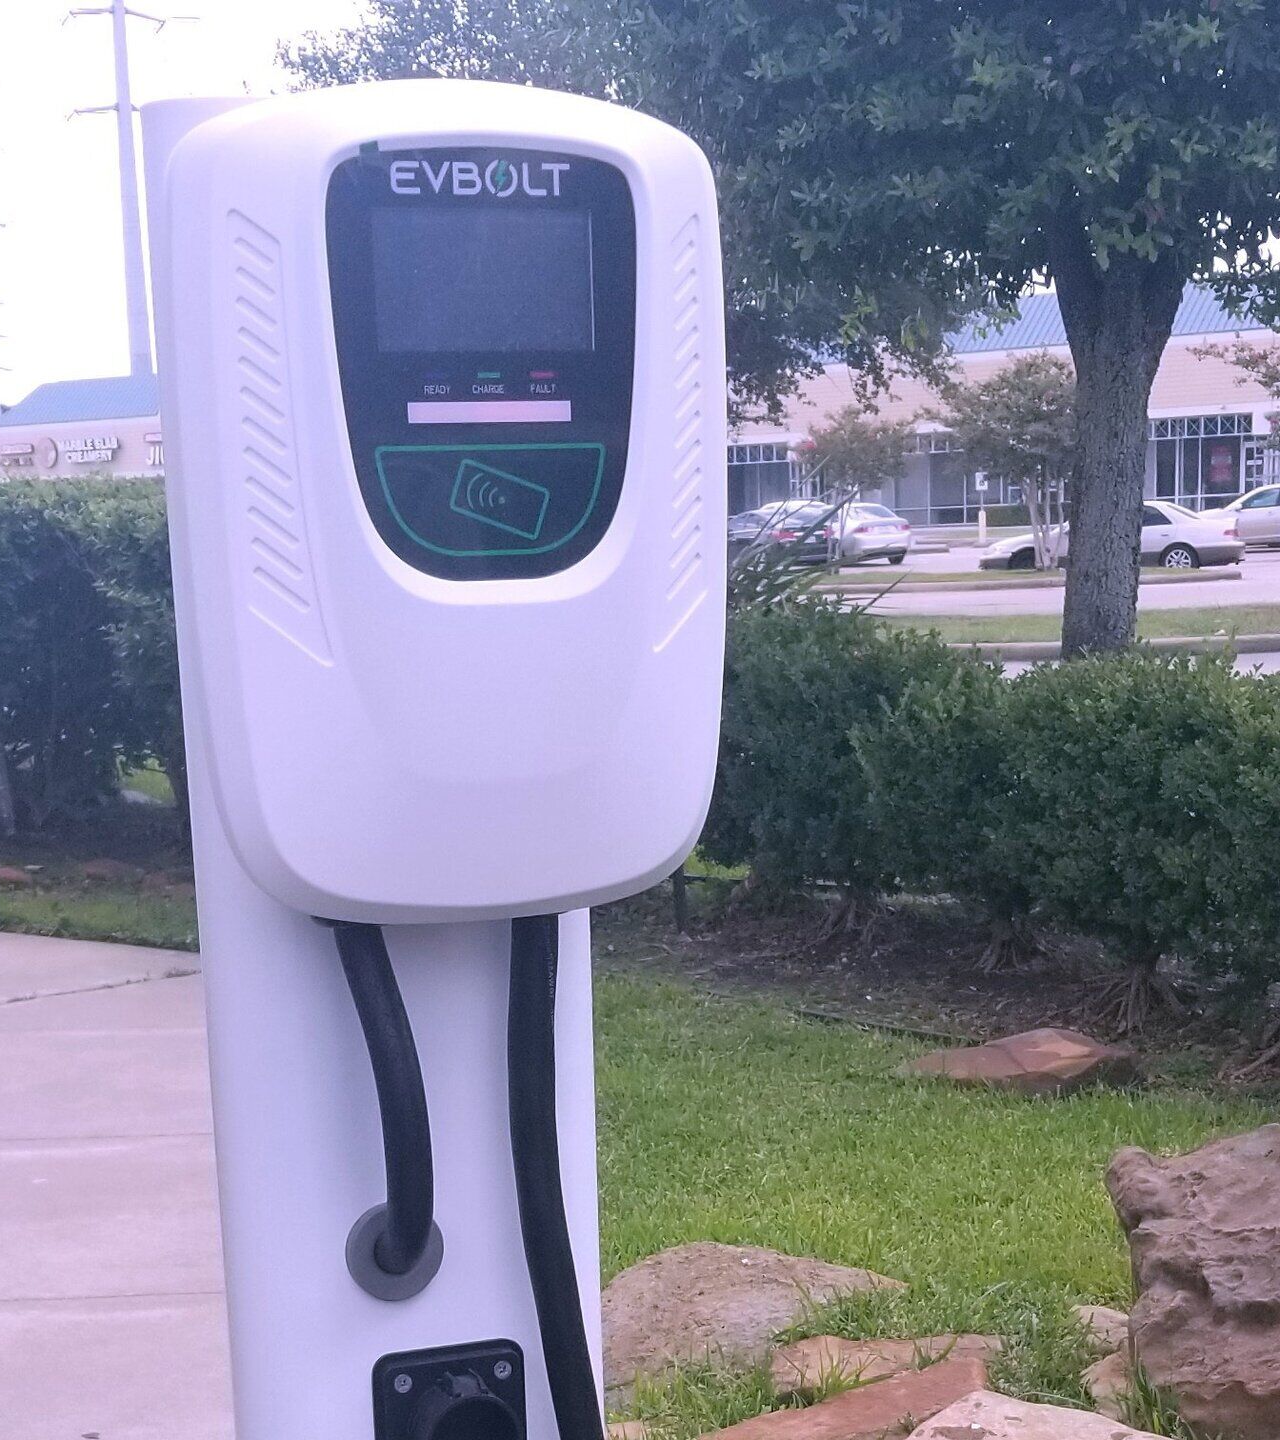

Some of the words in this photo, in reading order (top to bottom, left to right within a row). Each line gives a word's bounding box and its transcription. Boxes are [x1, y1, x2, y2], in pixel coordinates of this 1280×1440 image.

[390, 159, 570, 198] EVBOLT
[424, 384, 450, 395] READY
[472, 384, 504, 394] CHARGE
[530, 383, 556, 394] FAULT
